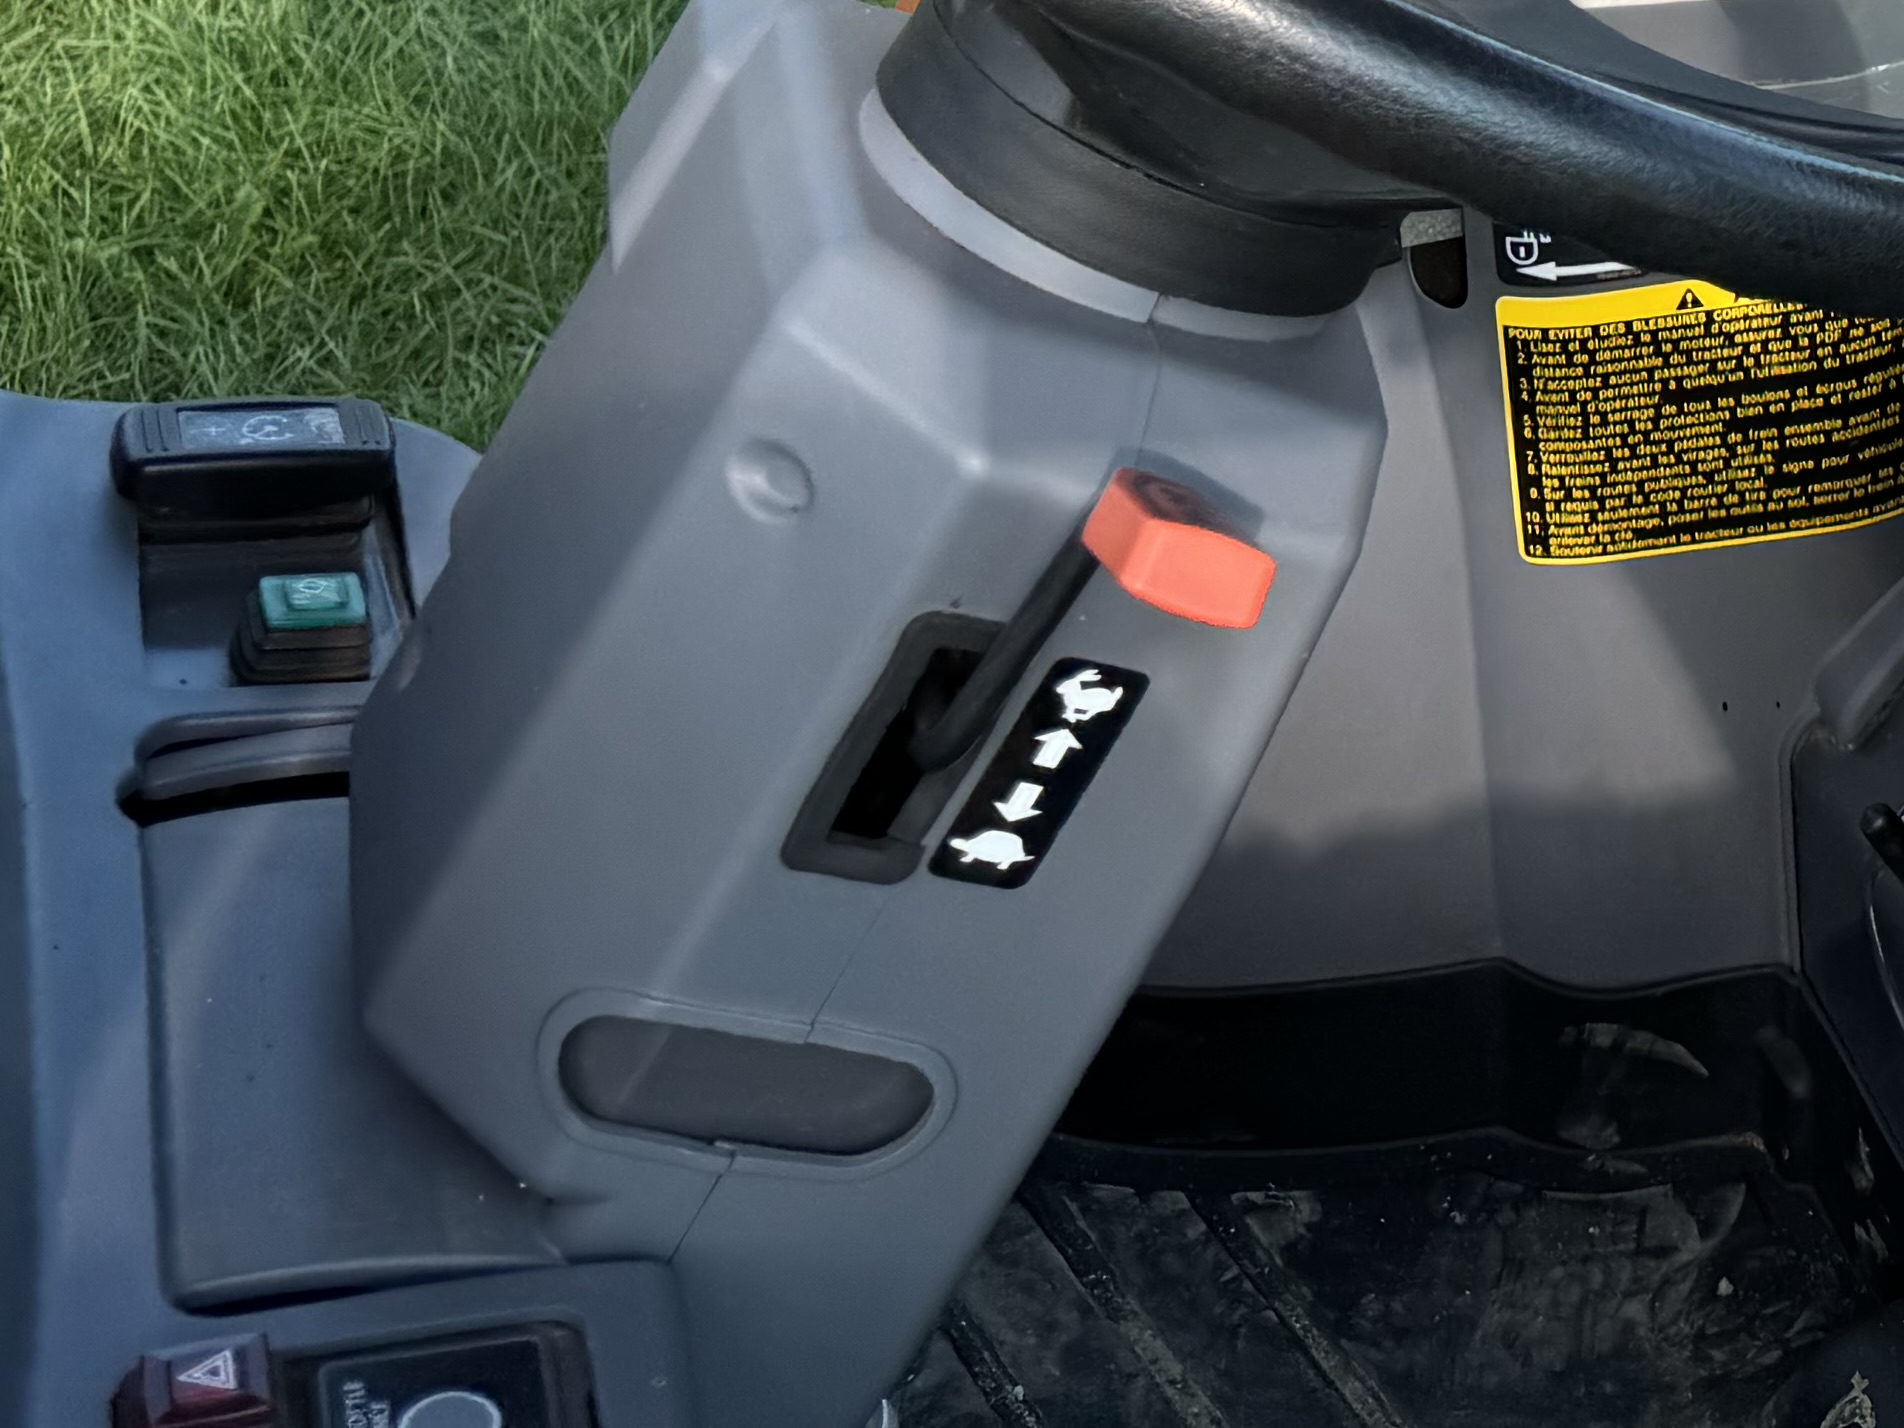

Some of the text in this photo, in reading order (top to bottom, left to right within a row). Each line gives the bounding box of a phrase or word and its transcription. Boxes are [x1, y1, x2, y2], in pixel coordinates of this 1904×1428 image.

[1573, 353, 1588, 363] de
[1661, 342, 1672, 352] le
[1669, 353, 1686, 364] du
[1576, 390, 1592, 400] de
[1661, 404, 1676, 415] de
